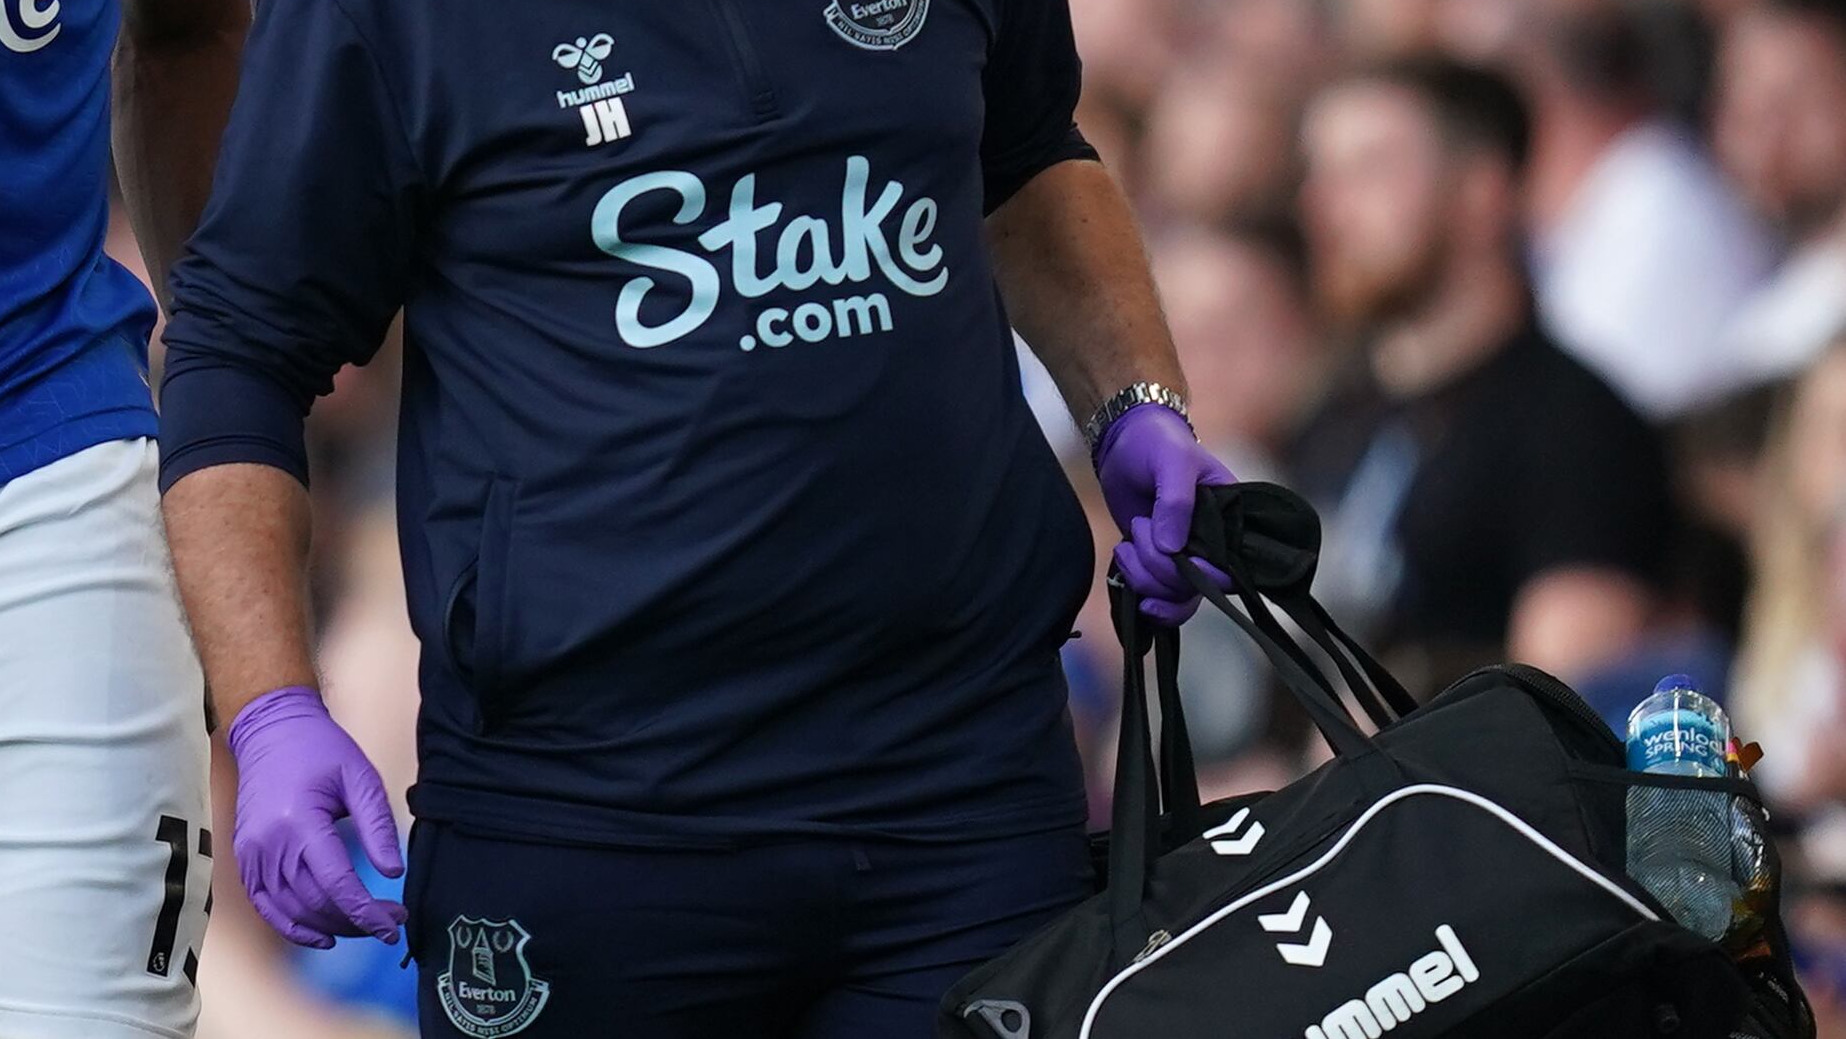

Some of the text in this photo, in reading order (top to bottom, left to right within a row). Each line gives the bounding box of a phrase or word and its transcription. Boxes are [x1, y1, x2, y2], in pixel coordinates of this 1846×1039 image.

[556, 72, 636, 109] hummel
[578, 96, 633, 147] JH
[591, 155, 950, 349] Stake
[739, 292, 894, 352] .com
[1645, 741, 1708, 758] SPRNG
[457, 980, 517, 1003] Everton
[1304, 923, 1481, 1039] mmel
